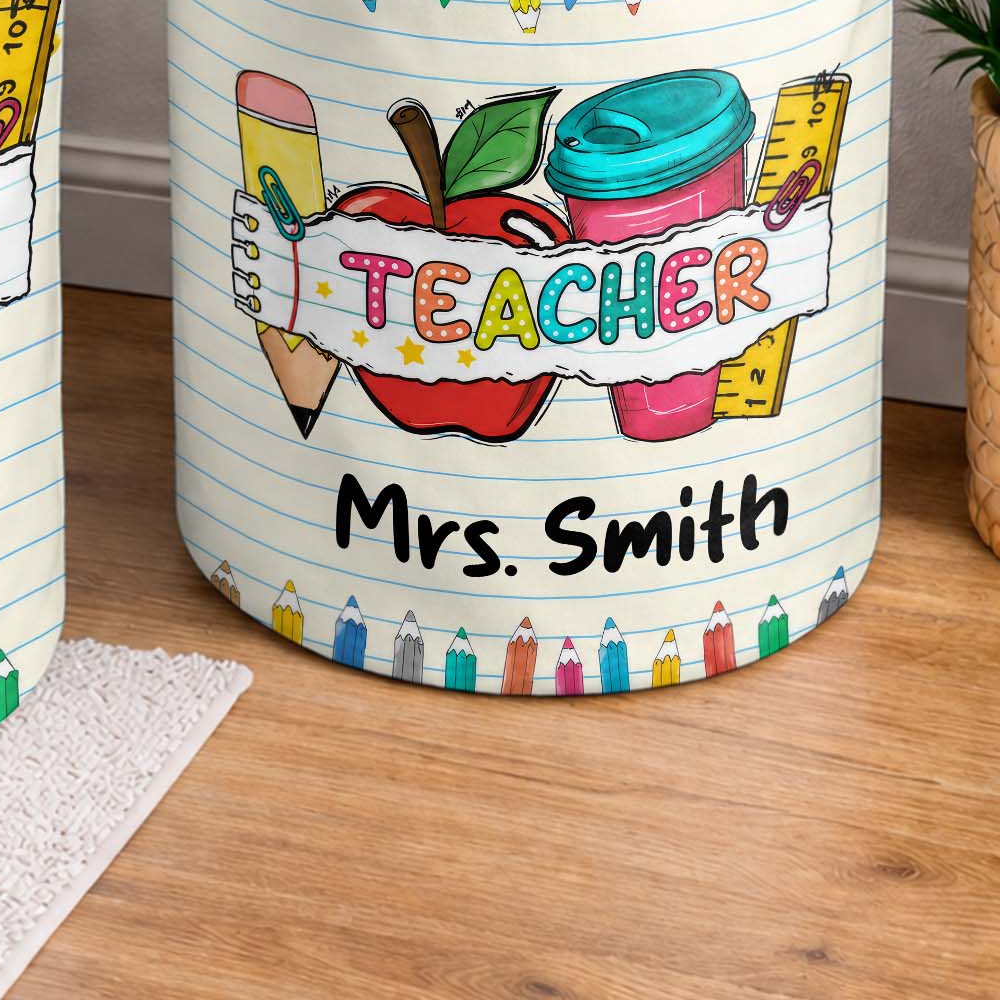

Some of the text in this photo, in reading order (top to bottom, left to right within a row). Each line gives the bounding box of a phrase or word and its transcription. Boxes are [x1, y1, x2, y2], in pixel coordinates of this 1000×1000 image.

[2, 19, 28, 56] 10
[807, 100, 827, 129] 10
[338, 236, 772, 352] TEACHER
[749, 367, 766, 386] 2
[744, 398, 767, 409] 1
[335, 472, 790, 578] Mrs. Smith
